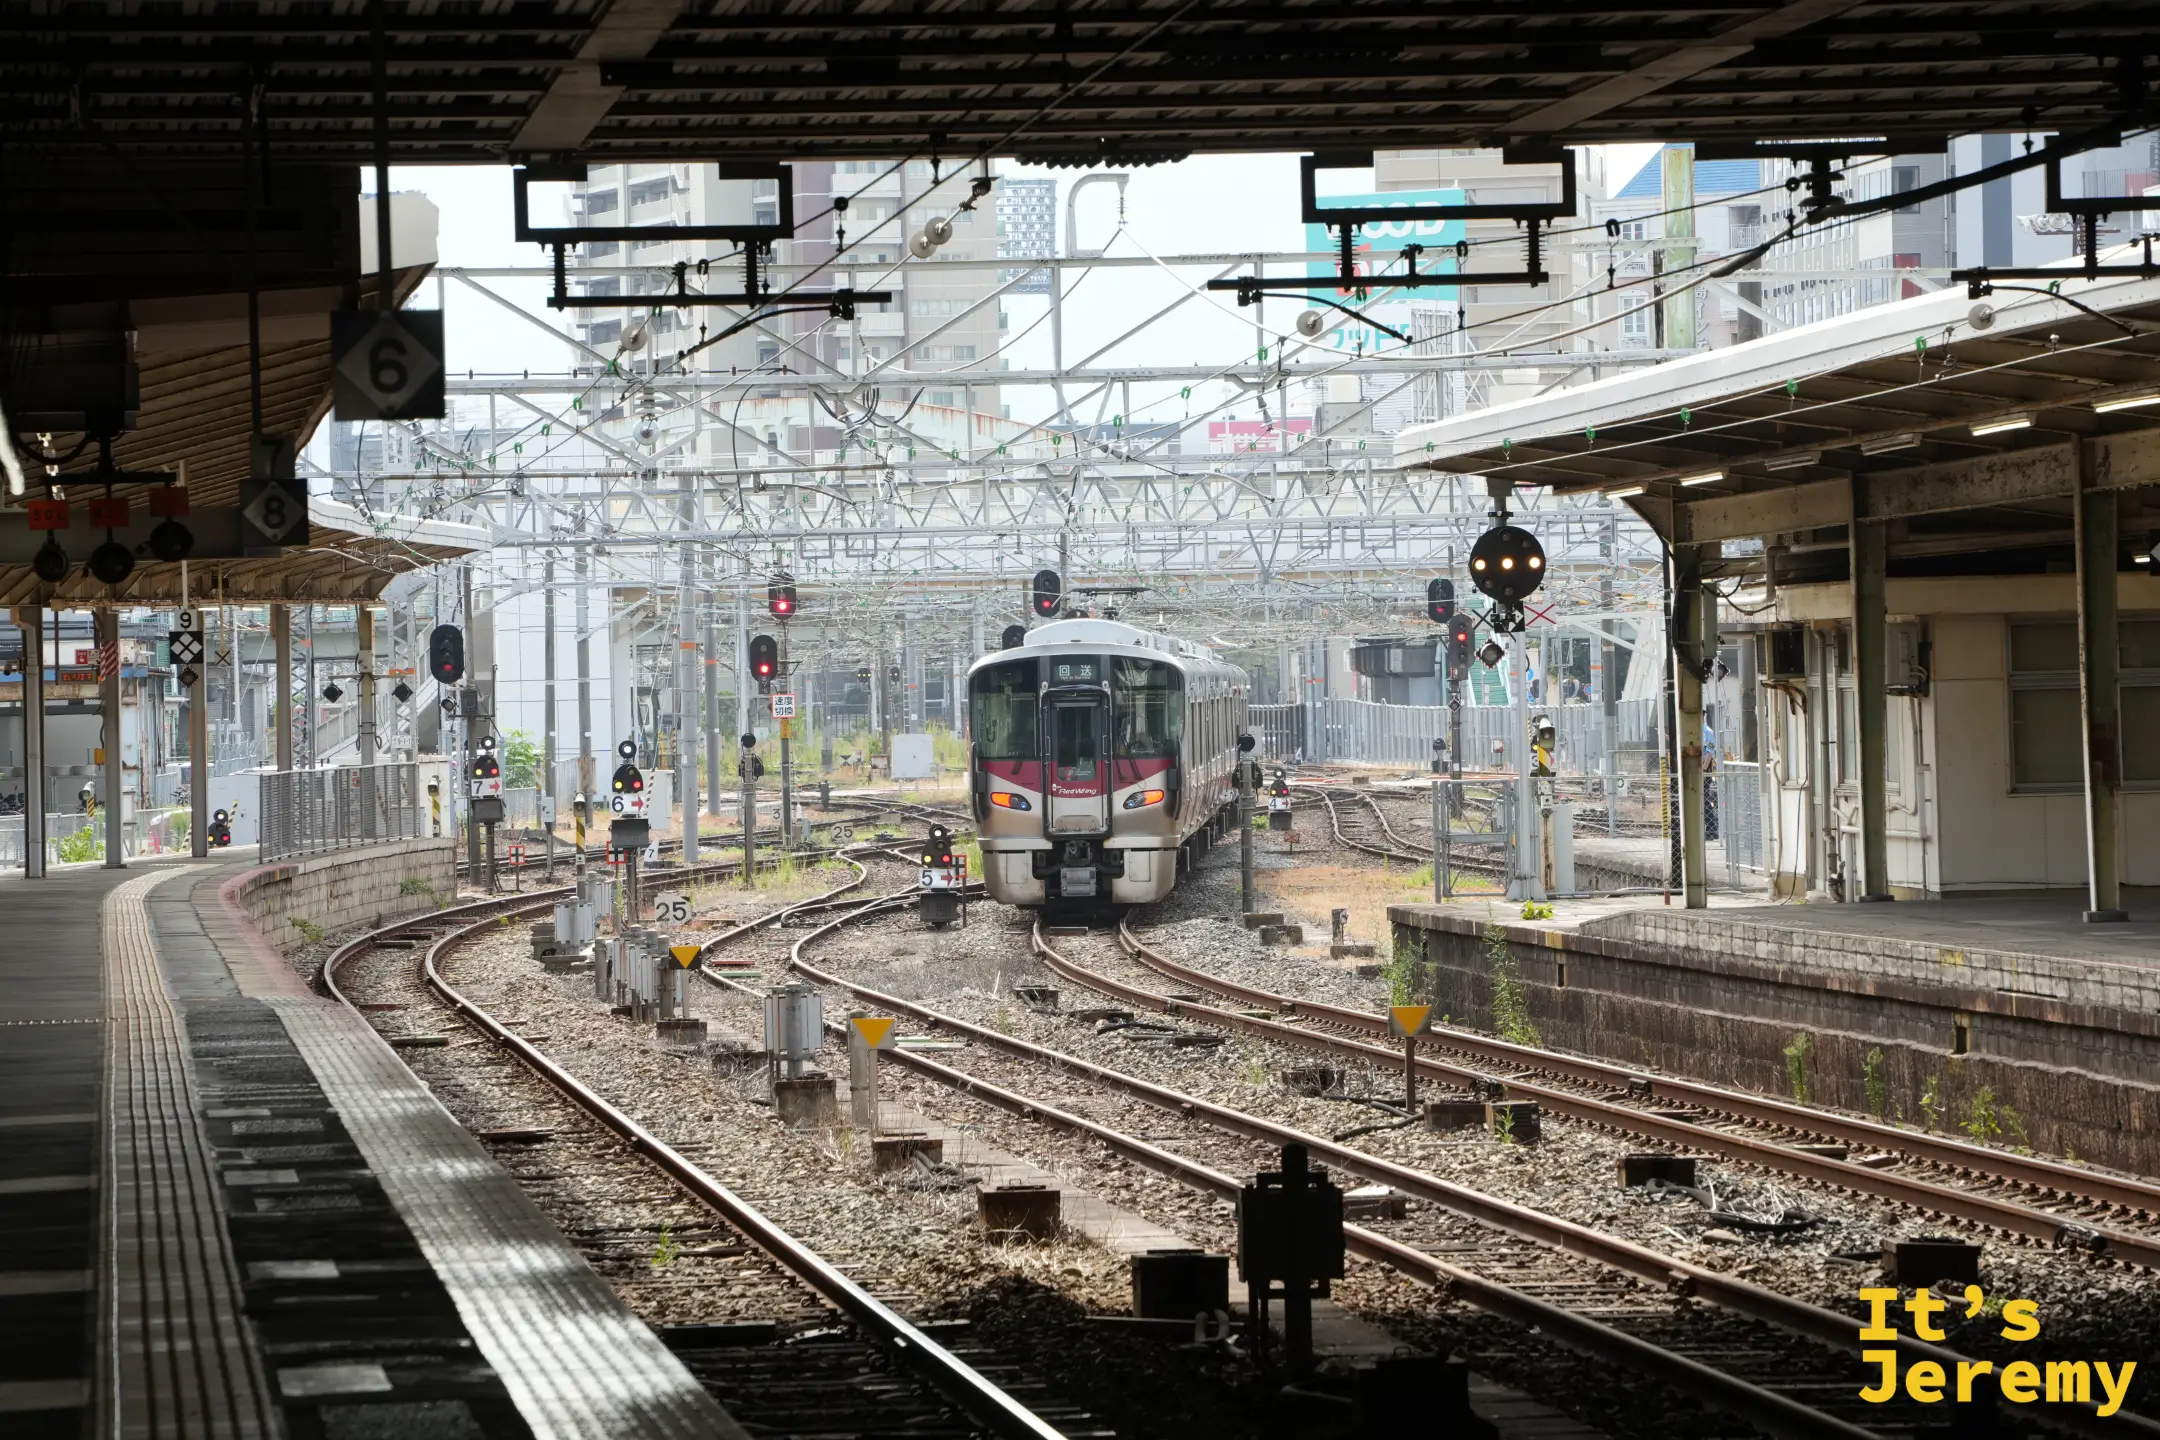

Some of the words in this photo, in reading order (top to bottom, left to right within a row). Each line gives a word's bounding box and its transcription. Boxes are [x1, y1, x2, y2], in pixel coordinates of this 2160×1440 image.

[368, 337, 408, 393] 6
[261, 438, 284, 479] 7
[263, 496, 286, 529] 8
[180, 611, 192, 628] 9
[1059, 665, 1092, 676] 回送
[774, 696, 793, 706] 速度
[775, 706, 794, 716] 切換
[473, 780, 483, 794] 7
[611, 795, 625, 813] 6
[1270, 798, 1278, 808] 4
[833, 825, 853, 839] 25
[648, 848, 655, 858] 7
[921, 869, 933, 886] 5
[655, 901, 688, 921] 25
